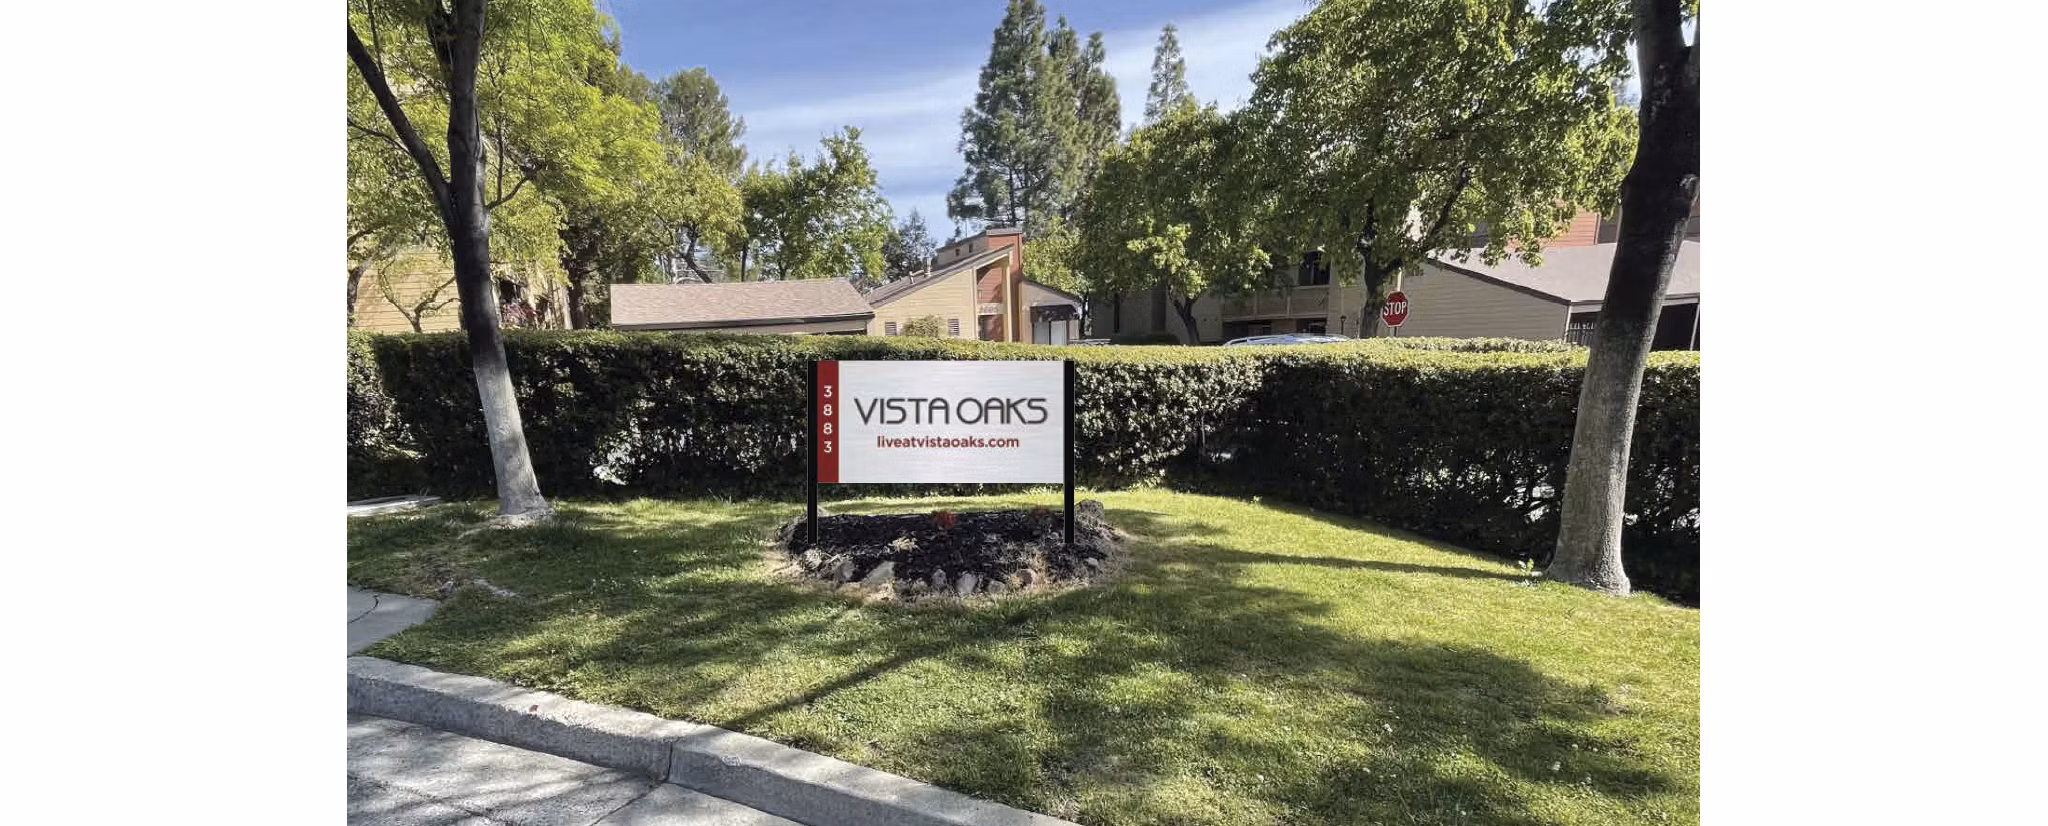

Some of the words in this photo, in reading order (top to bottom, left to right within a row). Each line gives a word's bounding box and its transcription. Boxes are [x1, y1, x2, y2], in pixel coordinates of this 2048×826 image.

[1383, 301, 1407, 316] STOP
[823, 385, 833, 453] 3883
[853, 397, 950, 425] VISTA
[956, 397, 1049, 425] OAKS
[876, 435, 1020, 449] liveatvistaoaks.com
